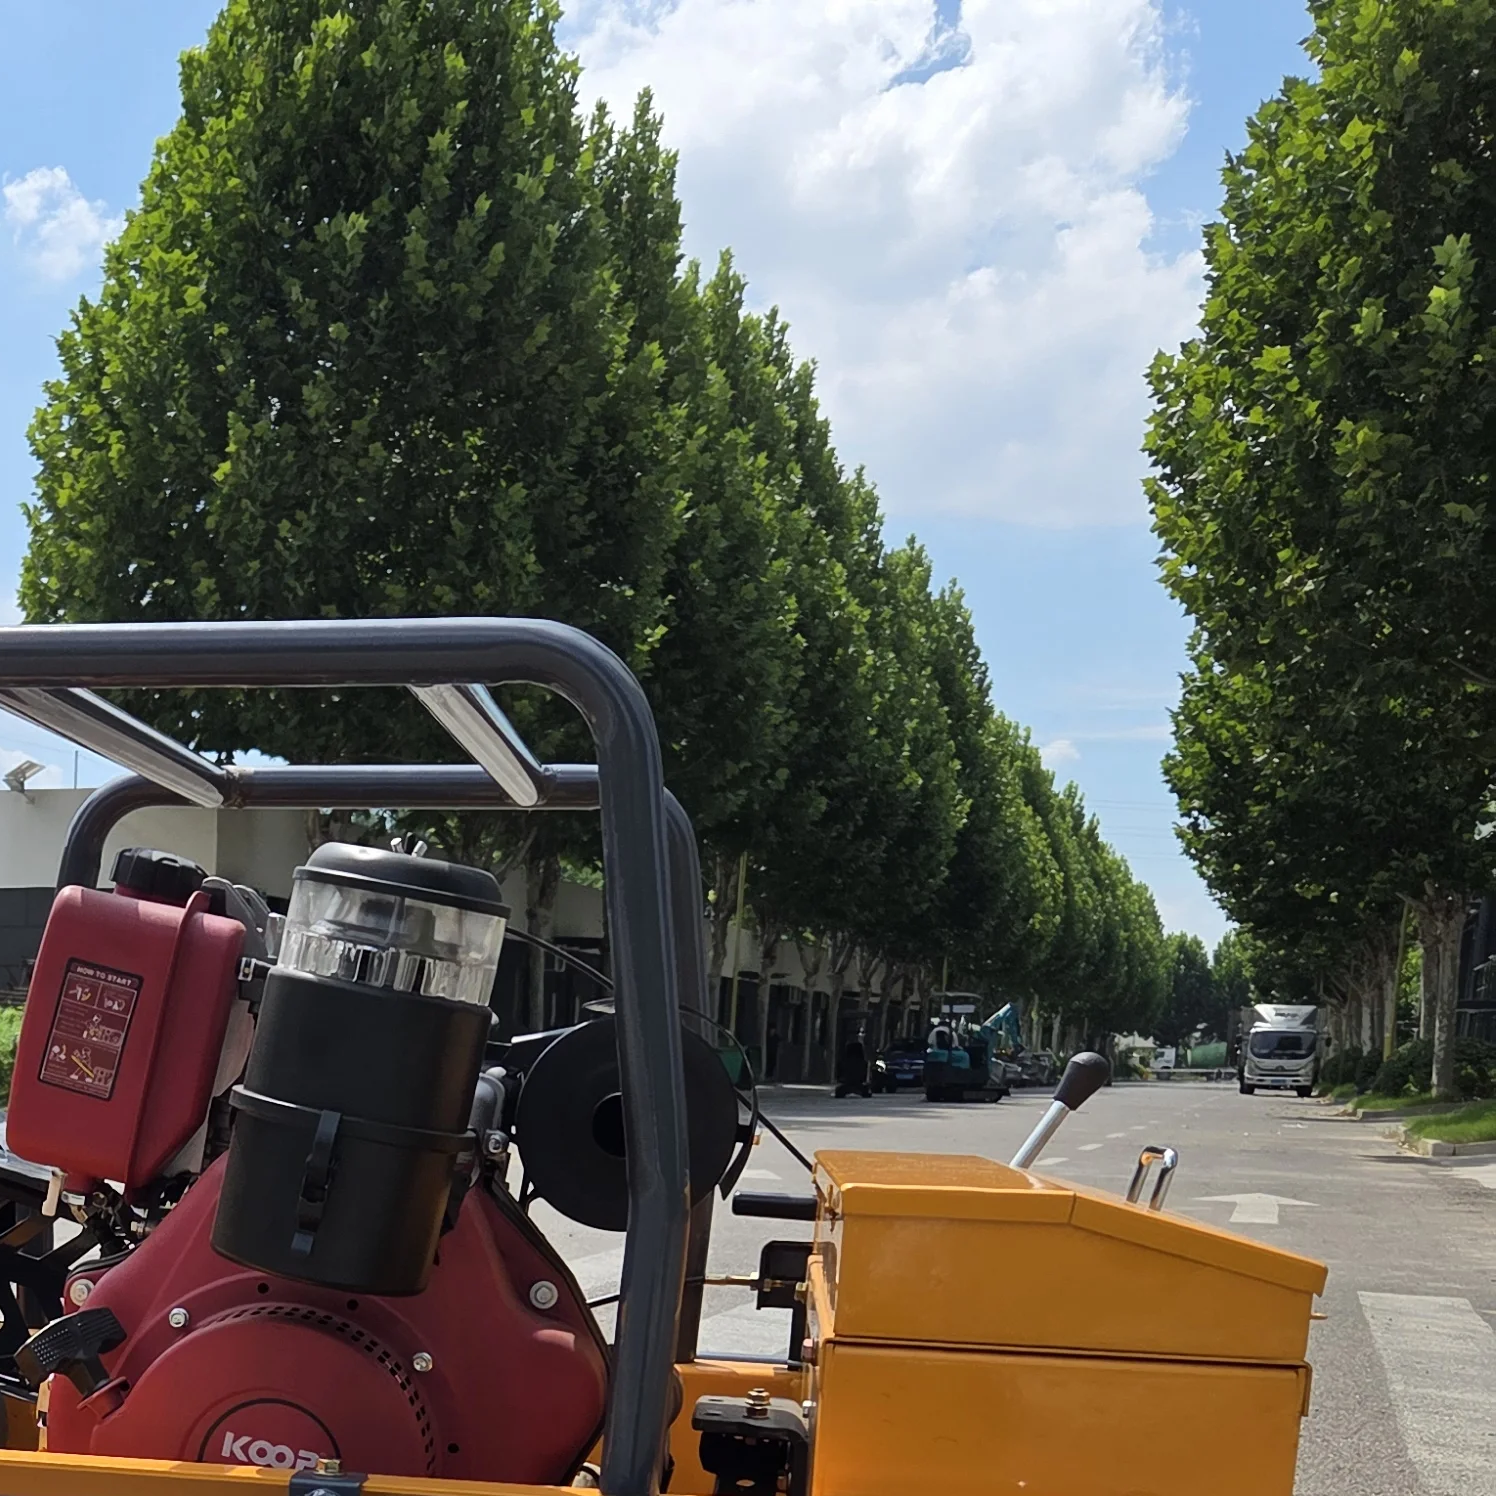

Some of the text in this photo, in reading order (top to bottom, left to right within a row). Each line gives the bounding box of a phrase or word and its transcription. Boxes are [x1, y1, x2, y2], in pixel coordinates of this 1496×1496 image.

[76, 966, 95, 976] HOW
[96, 970, 106, 980] TO
[107, 974, 132, 987] START
[221, 1430, 320, 1471] KOOP
